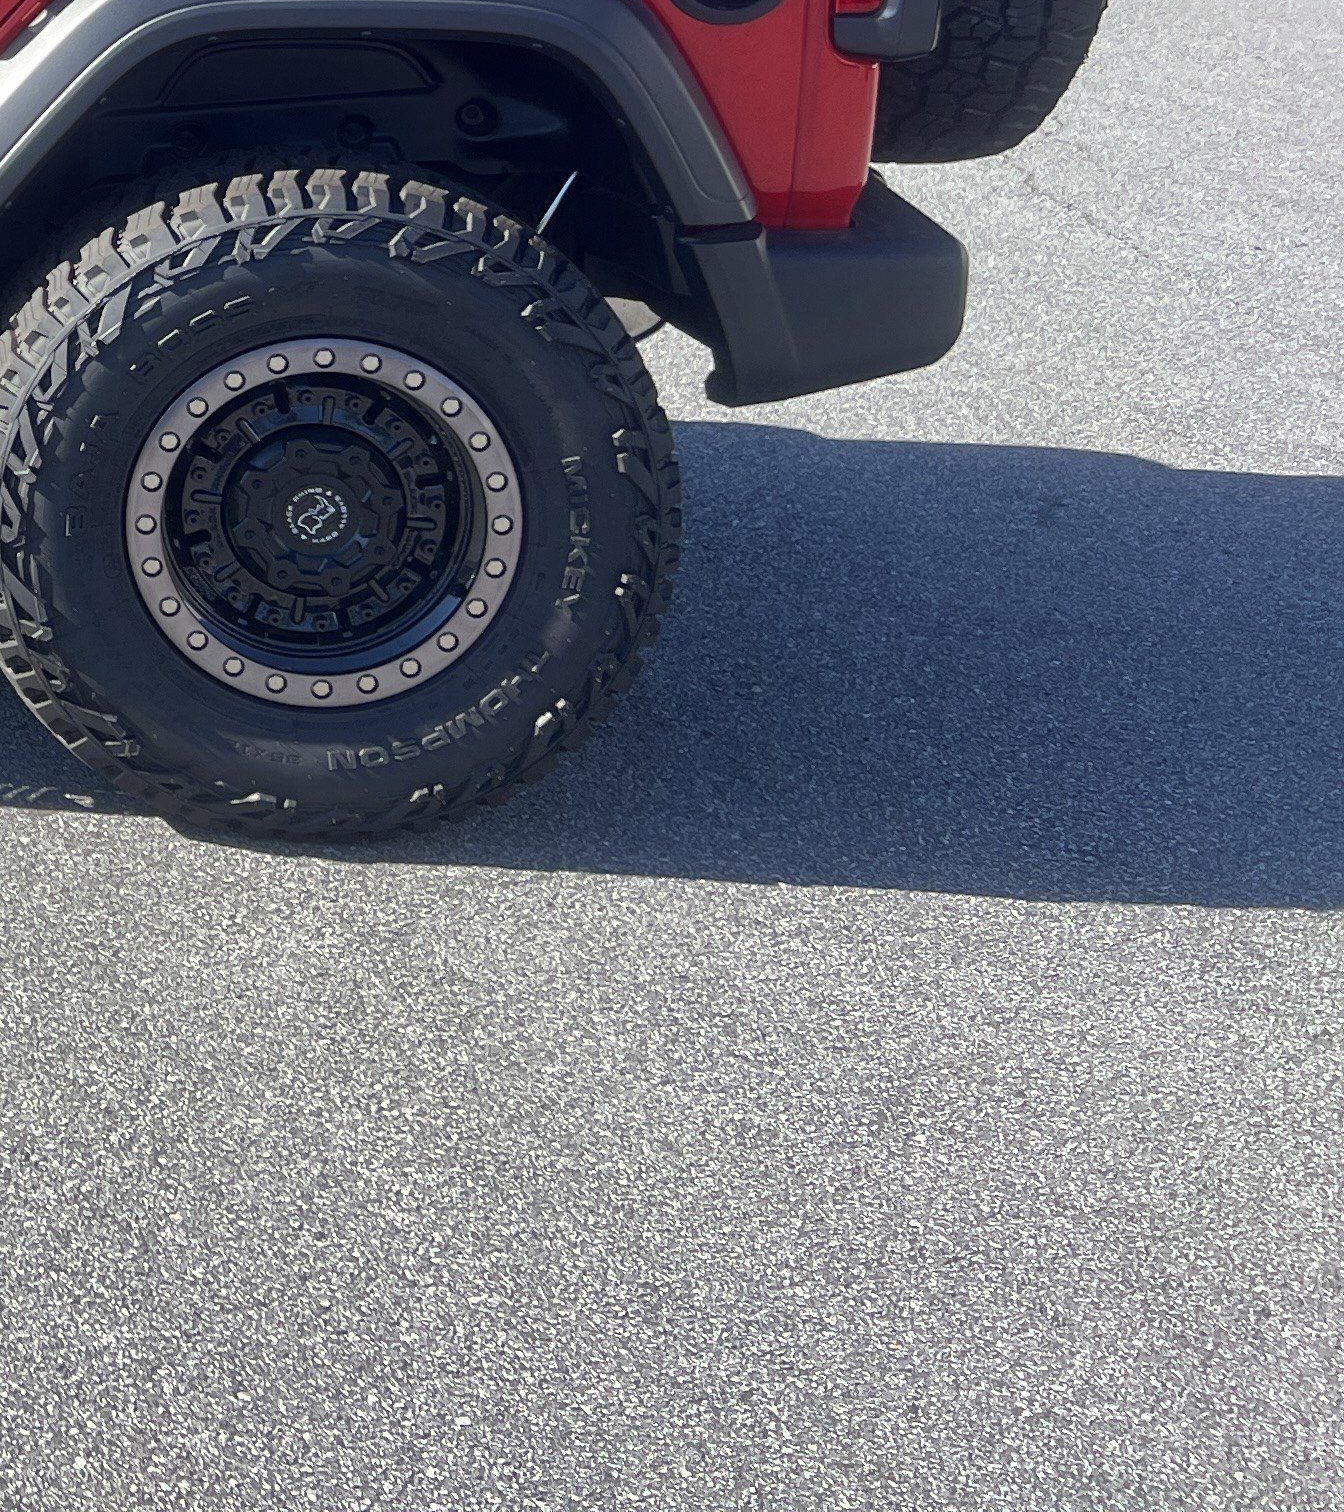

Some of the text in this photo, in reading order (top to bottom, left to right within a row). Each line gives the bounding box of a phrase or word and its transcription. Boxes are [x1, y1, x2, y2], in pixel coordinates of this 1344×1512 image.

[130, 294, 257, 378] BOSS
[326, 454, 589, 774] MICKEY THOMPSON
